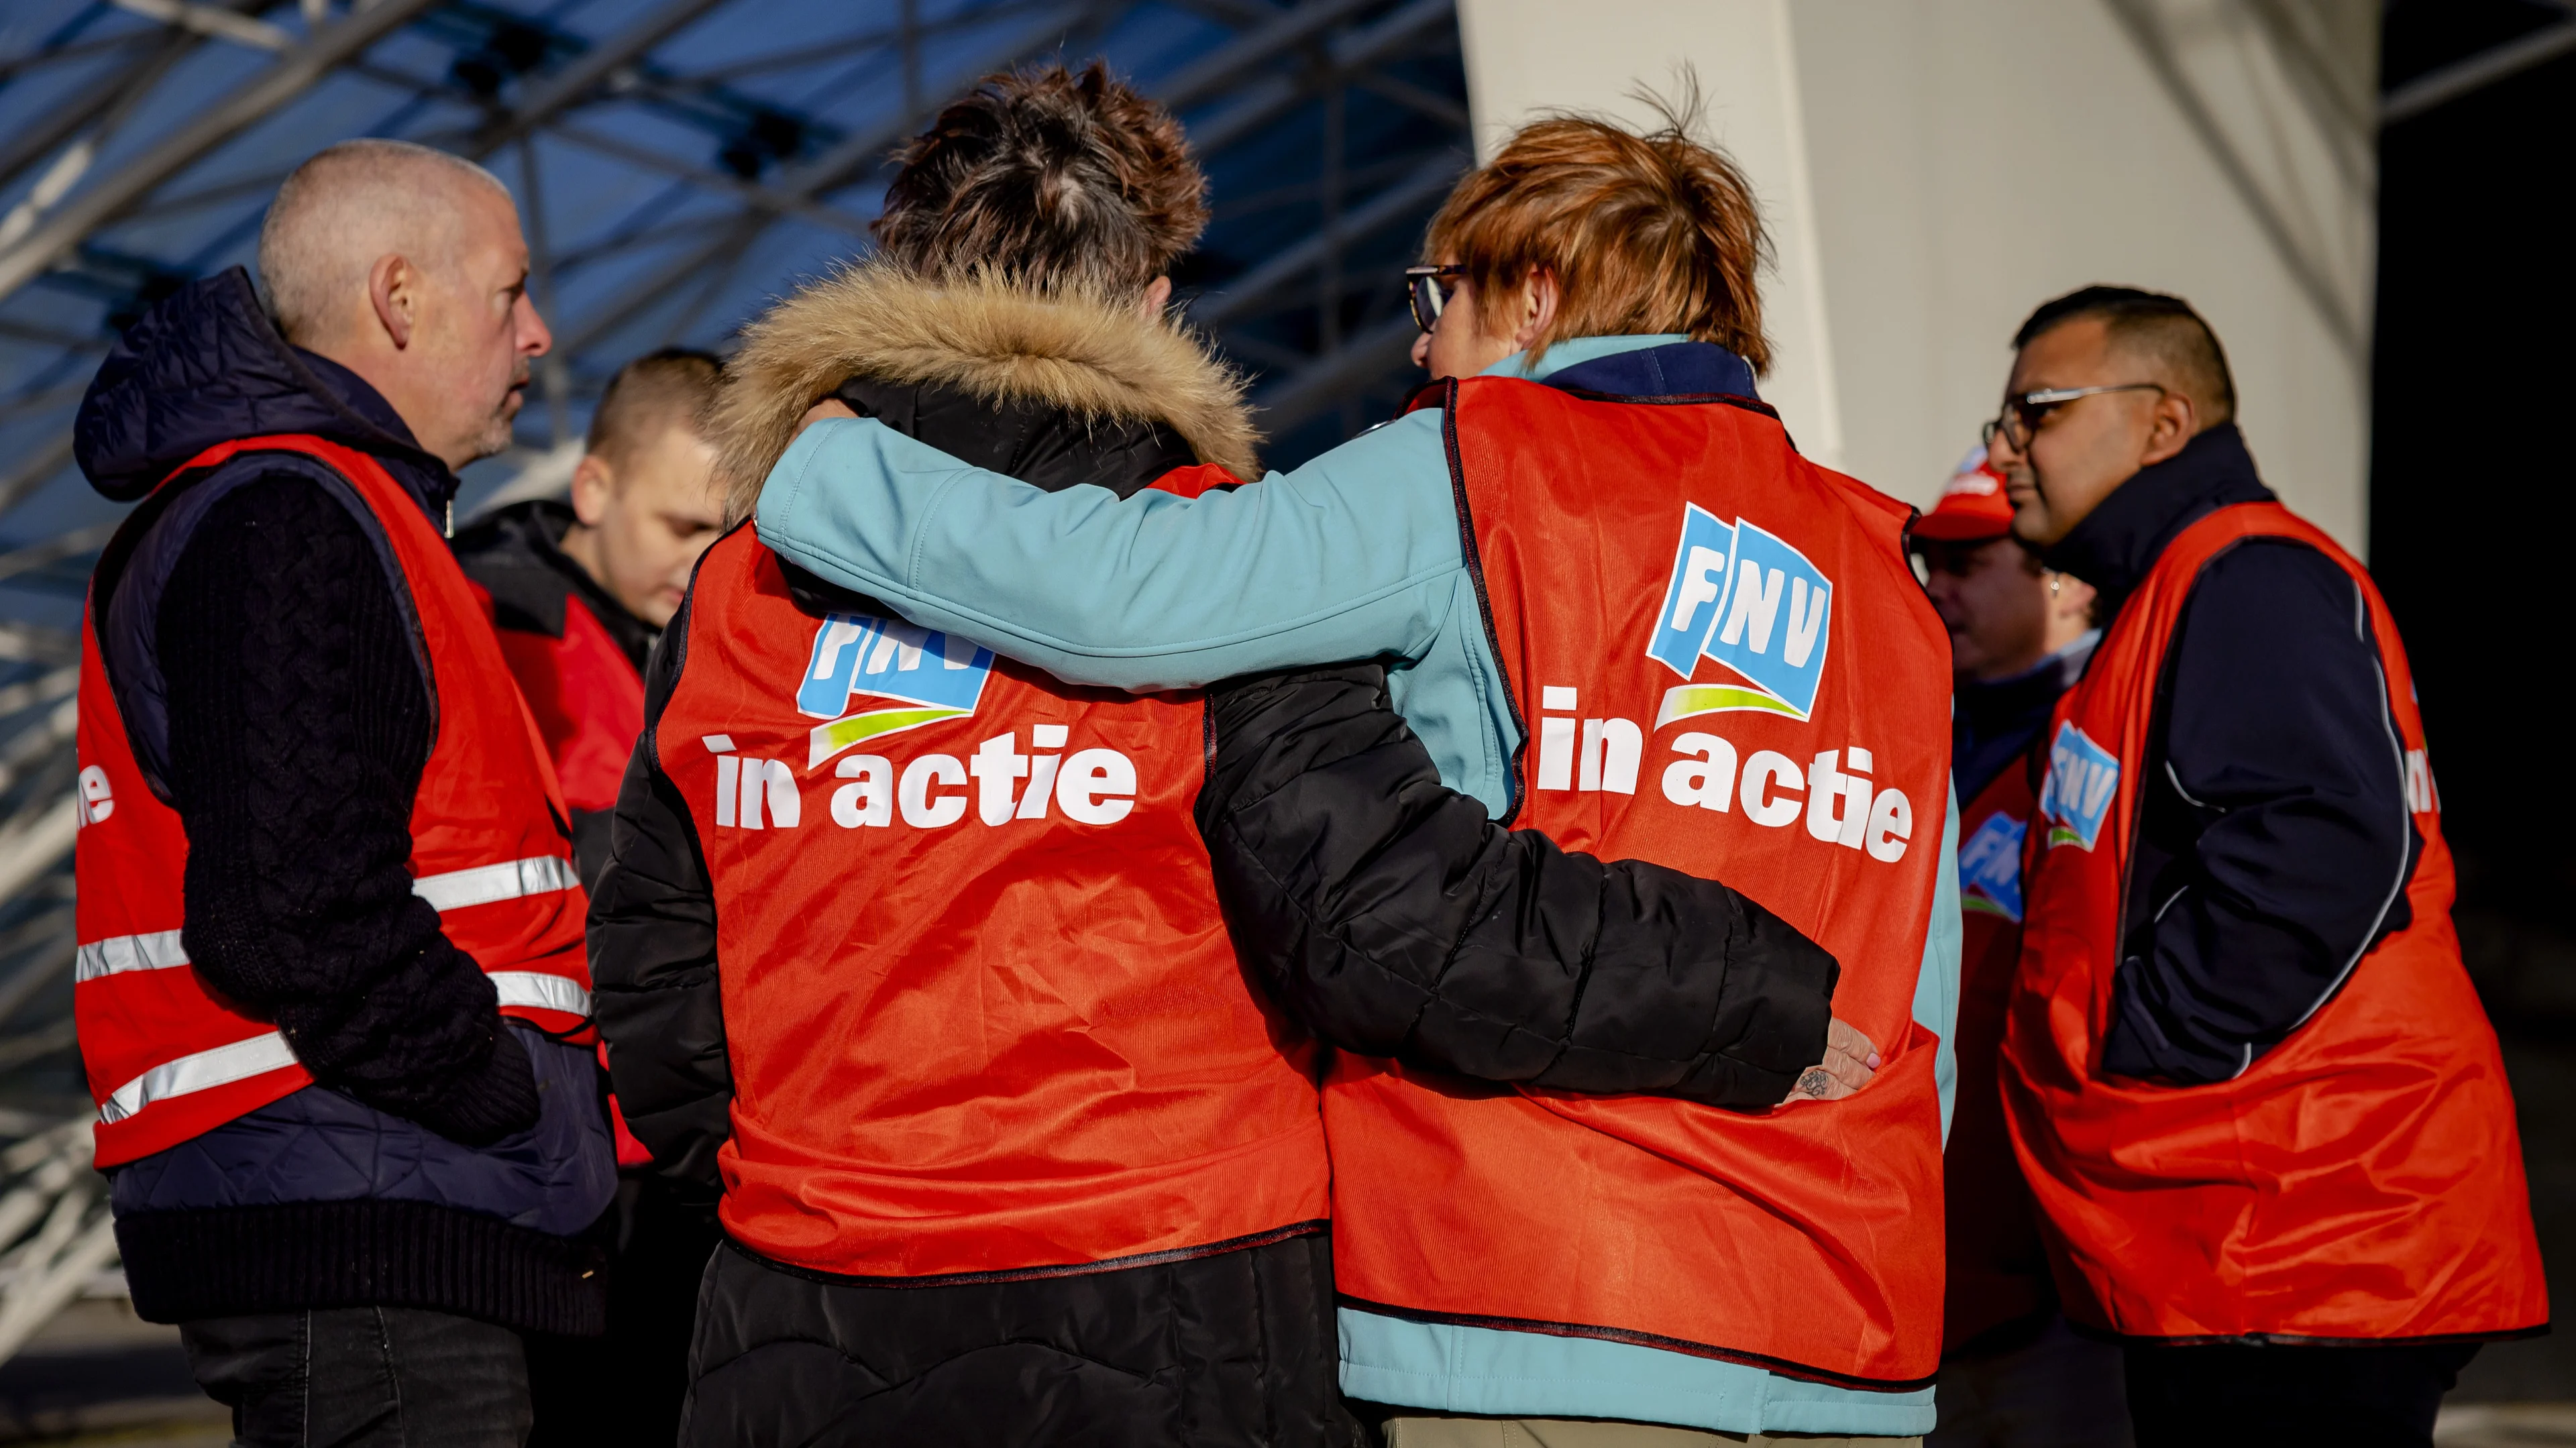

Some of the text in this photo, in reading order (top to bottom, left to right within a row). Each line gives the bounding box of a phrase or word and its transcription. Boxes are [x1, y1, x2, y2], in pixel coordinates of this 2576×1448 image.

[1670, 545, 1826, 668] FNV
[702, 724, 1137, 830] in actie
[1538, 685, 1913, 863] in actie
